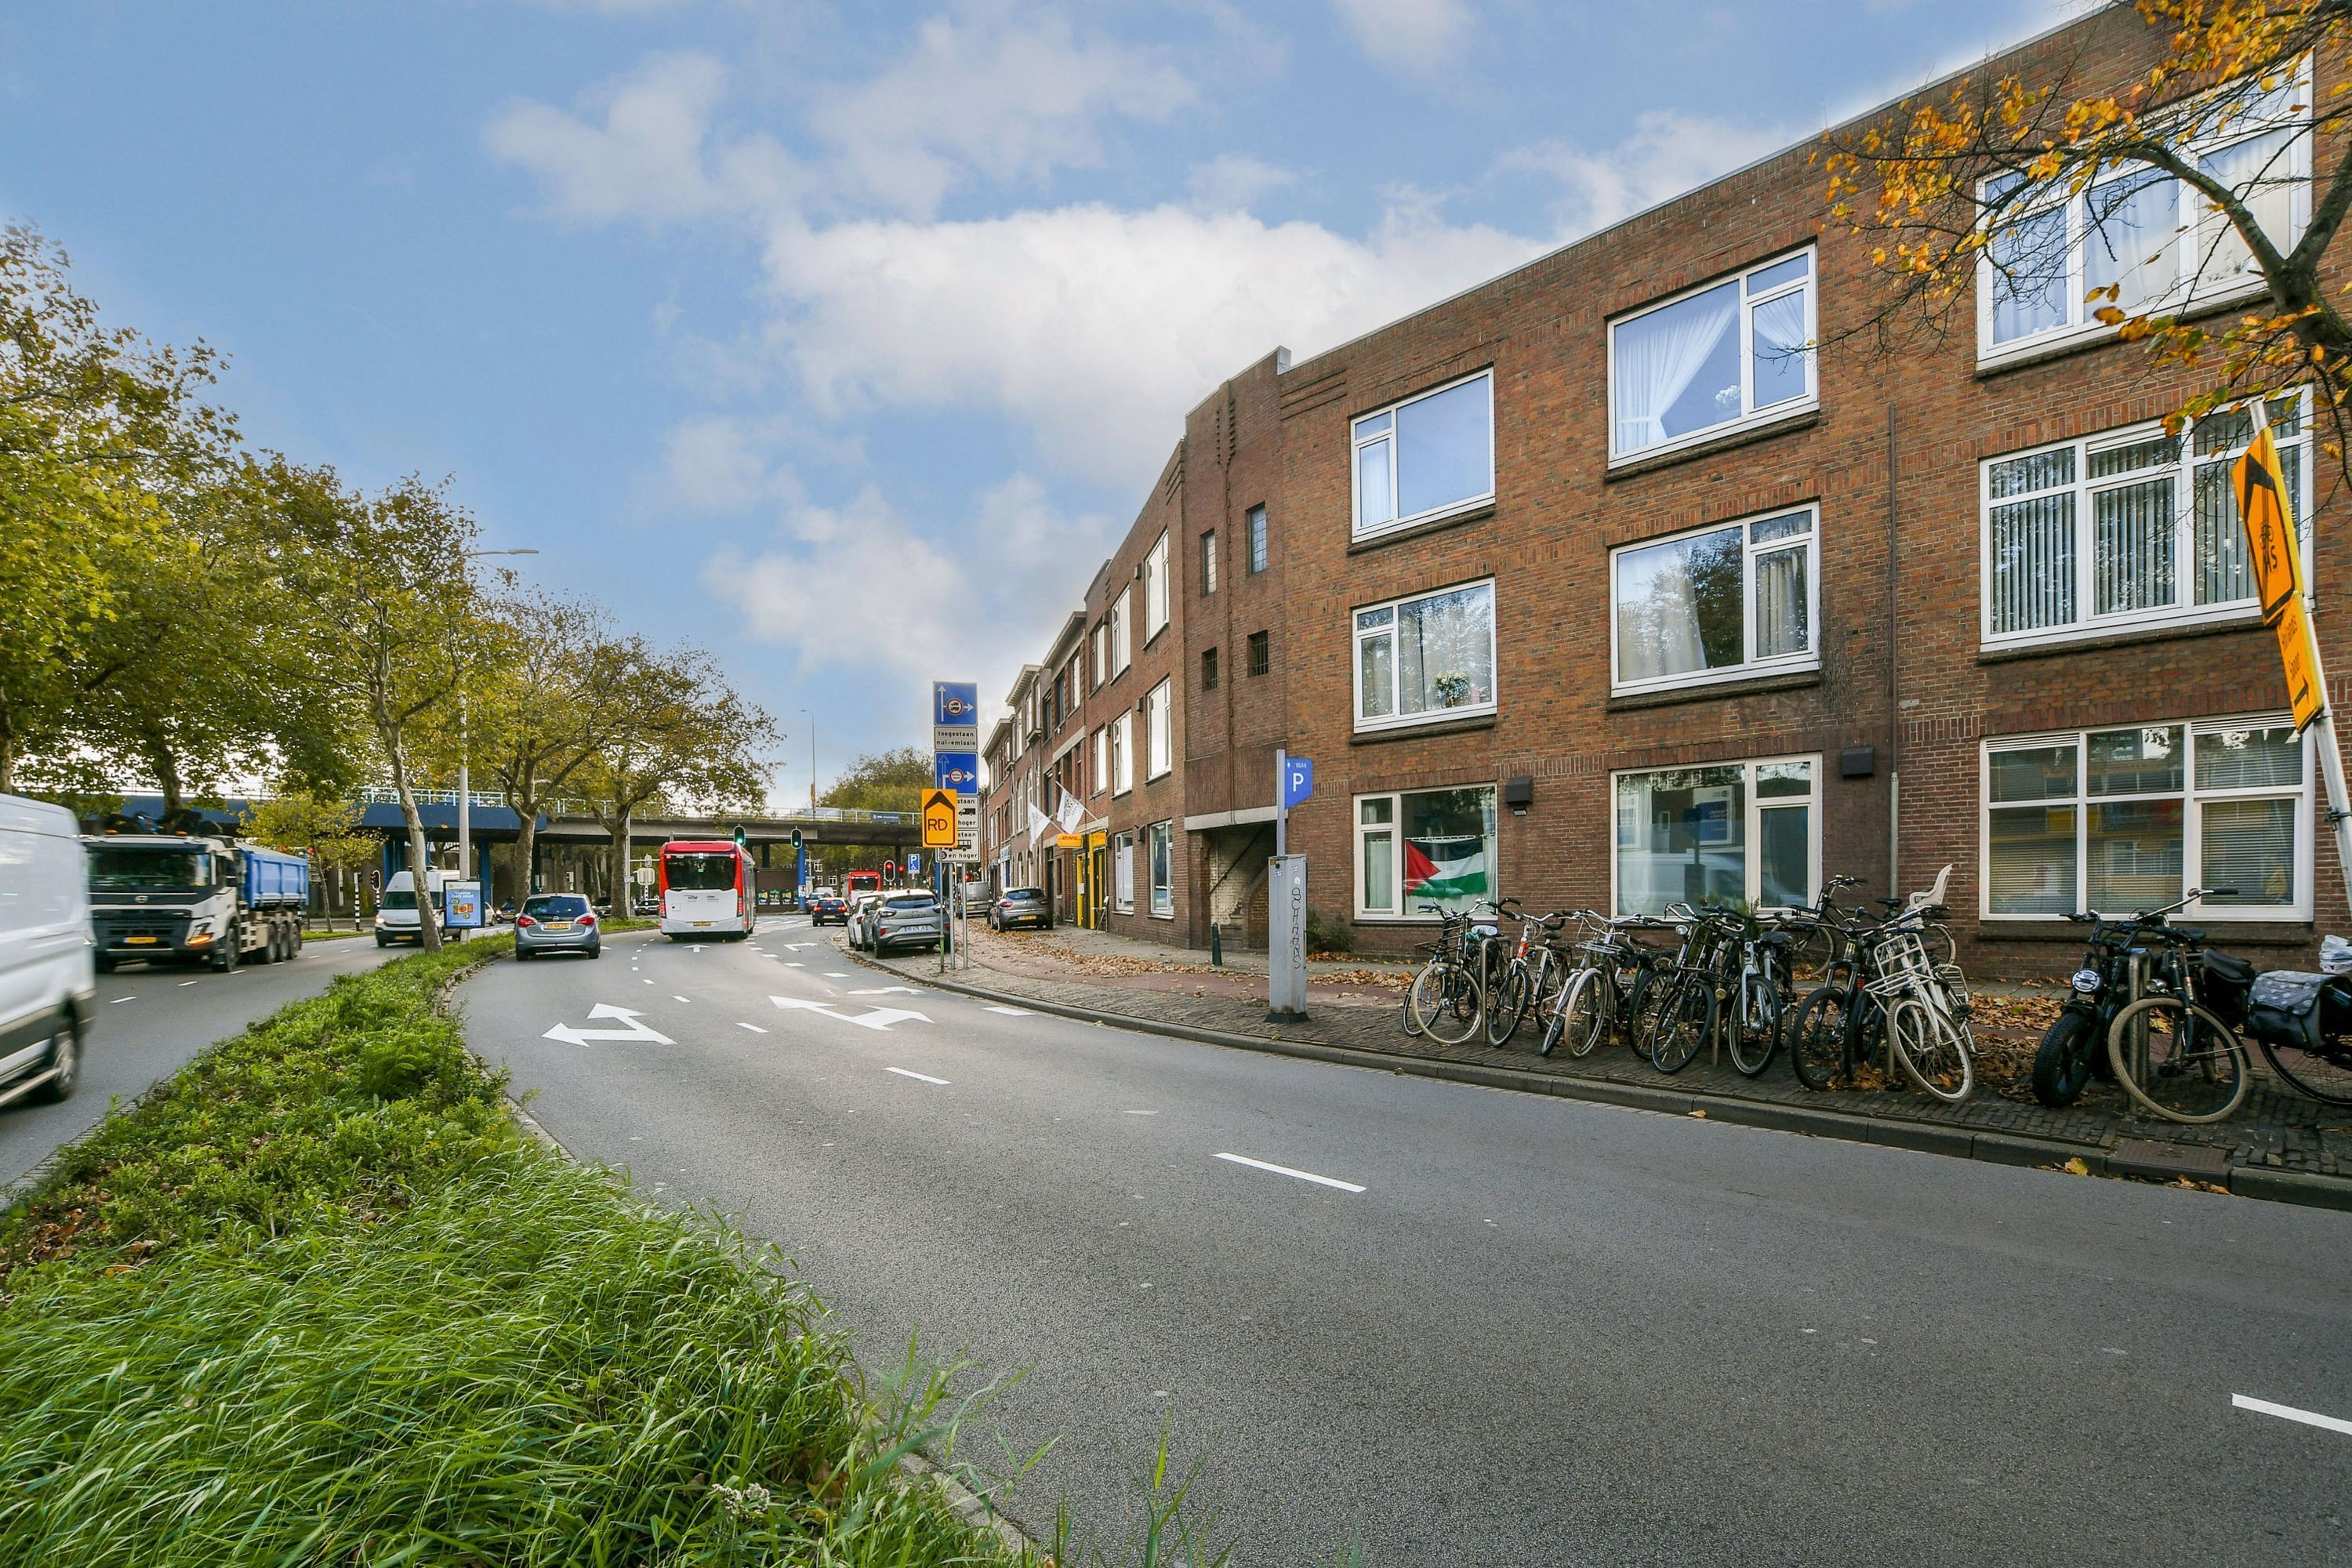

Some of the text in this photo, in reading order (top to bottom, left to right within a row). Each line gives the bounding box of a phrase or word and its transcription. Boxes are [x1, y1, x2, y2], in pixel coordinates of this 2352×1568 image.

[1293, 772, 1304, 792] P
[927, 818, 948, 831] RD
[910, 855, 917, 864] P
